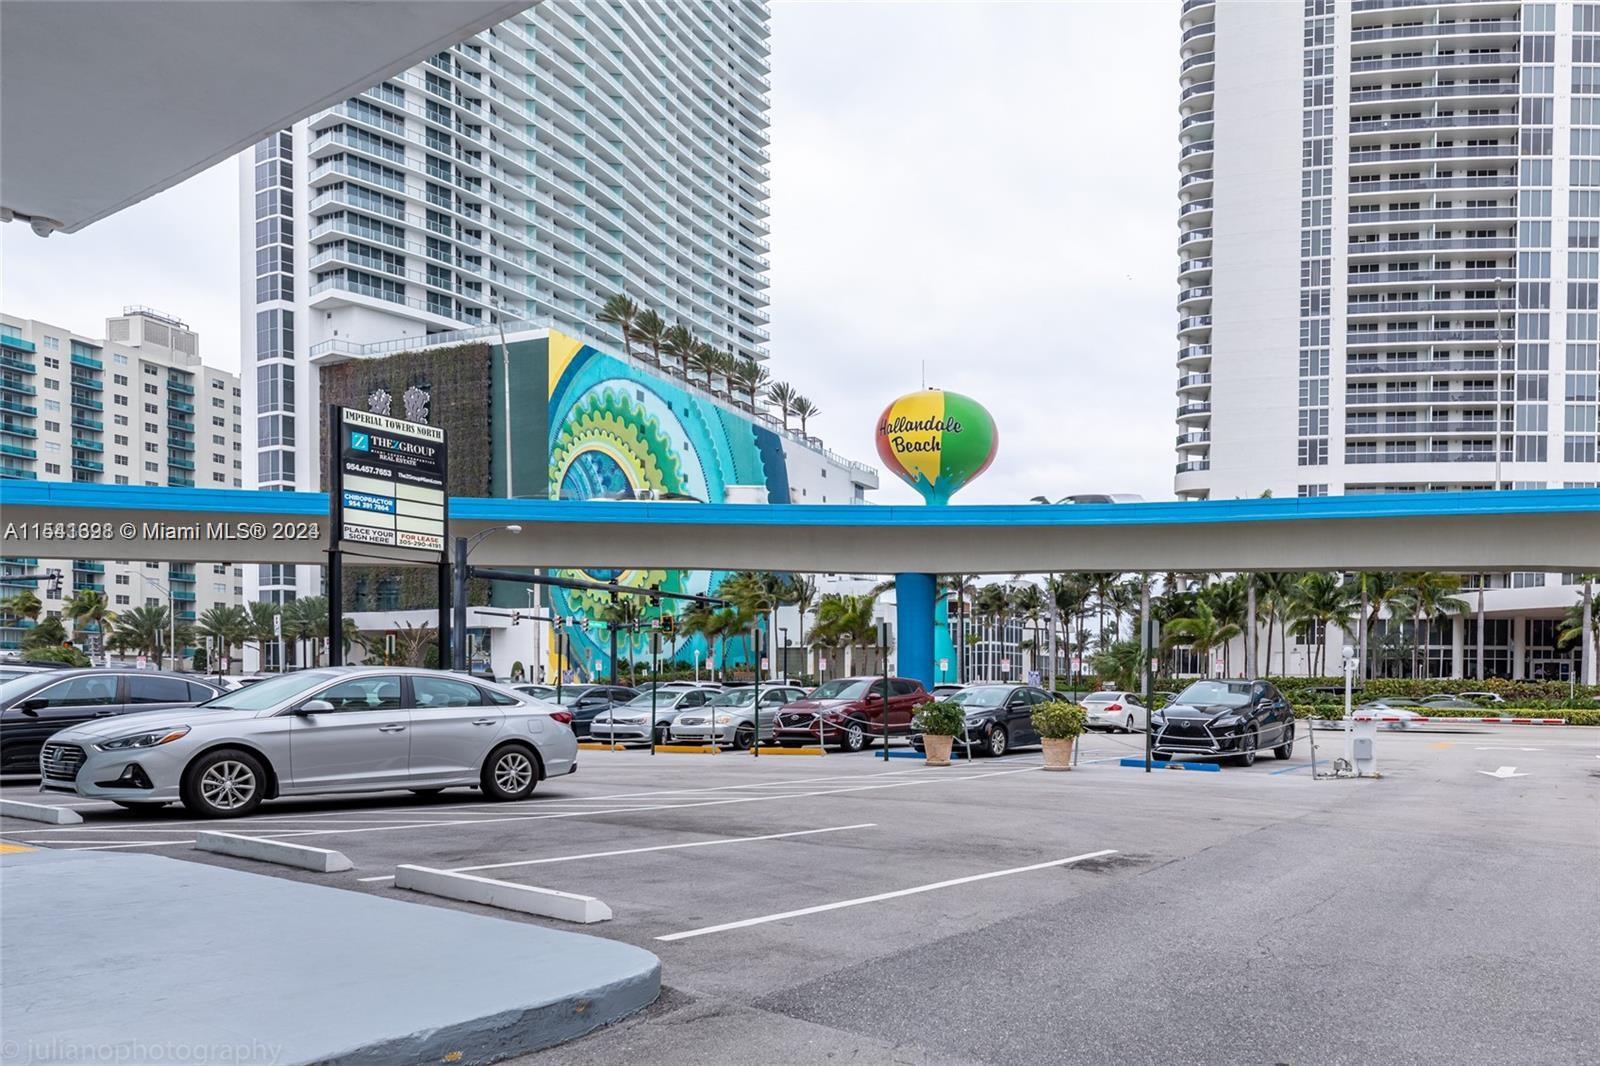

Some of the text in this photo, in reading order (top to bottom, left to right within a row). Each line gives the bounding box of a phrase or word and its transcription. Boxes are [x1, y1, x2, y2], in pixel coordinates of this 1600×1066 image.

[345, 410, 441, 439] IMPERIAL TOWERS NORTH
[880, 415, 962, 436] Hallandale
[370, 435, 435, 457] THEZGROUP
[891, 436, 941, 453] Beach
[379, 454, 417, 466] REAL ESTATE
[344, 493, 393, 506] CHIROPRACTOR
[344, 526, 394, 538] PLACE YOUR
[348, 533, 389, 543] SIGN HERE
[401, 533, 439, 544] FOR LEASE
